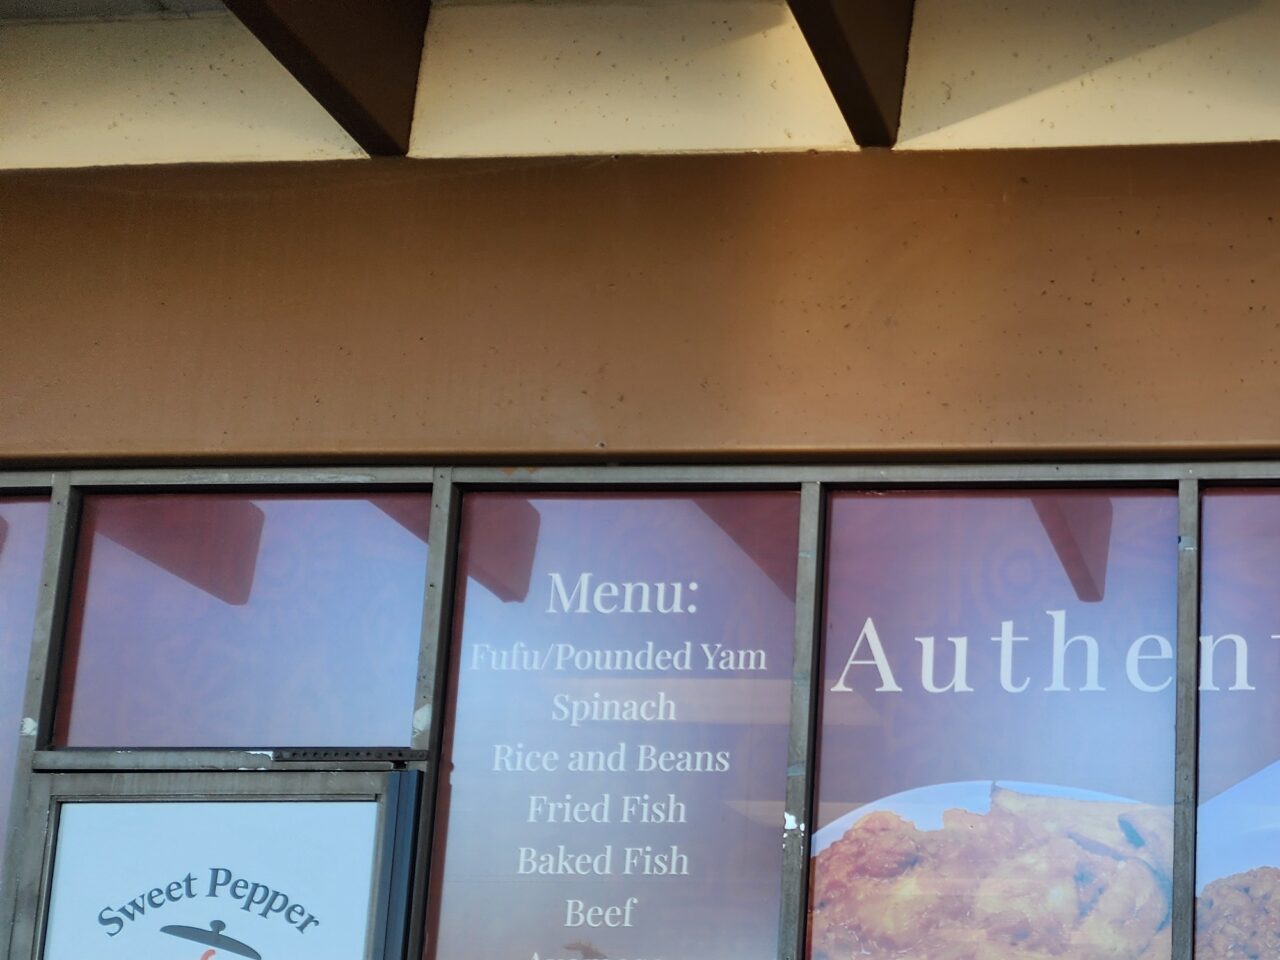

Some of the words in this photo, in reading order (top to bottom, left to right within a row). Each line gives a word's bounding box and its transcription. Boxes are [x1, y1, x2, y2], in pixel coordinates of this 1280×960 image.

[545, 571, 700, 615] Menu:
[469, 641, 693, 672] Fufu/Pounded
[699, 643, 768, 672] Yam
[551, 692, 678, 727] Spinach
[491, 743, 559, 773] Rice
[567, 743, 627, 773] and
[636, 744, 730, 773] Beans
[526, 794, 611, 824] Fried
[621, 794, 687, 824] Fish
[516, 846, 612, 875] Baked
[623, 846, 690, 876] Fish
[98, 872, 198, 937] Sweet
[205, 867, 320, 935] Pepper
[563, 897, 638, 928] Beef
